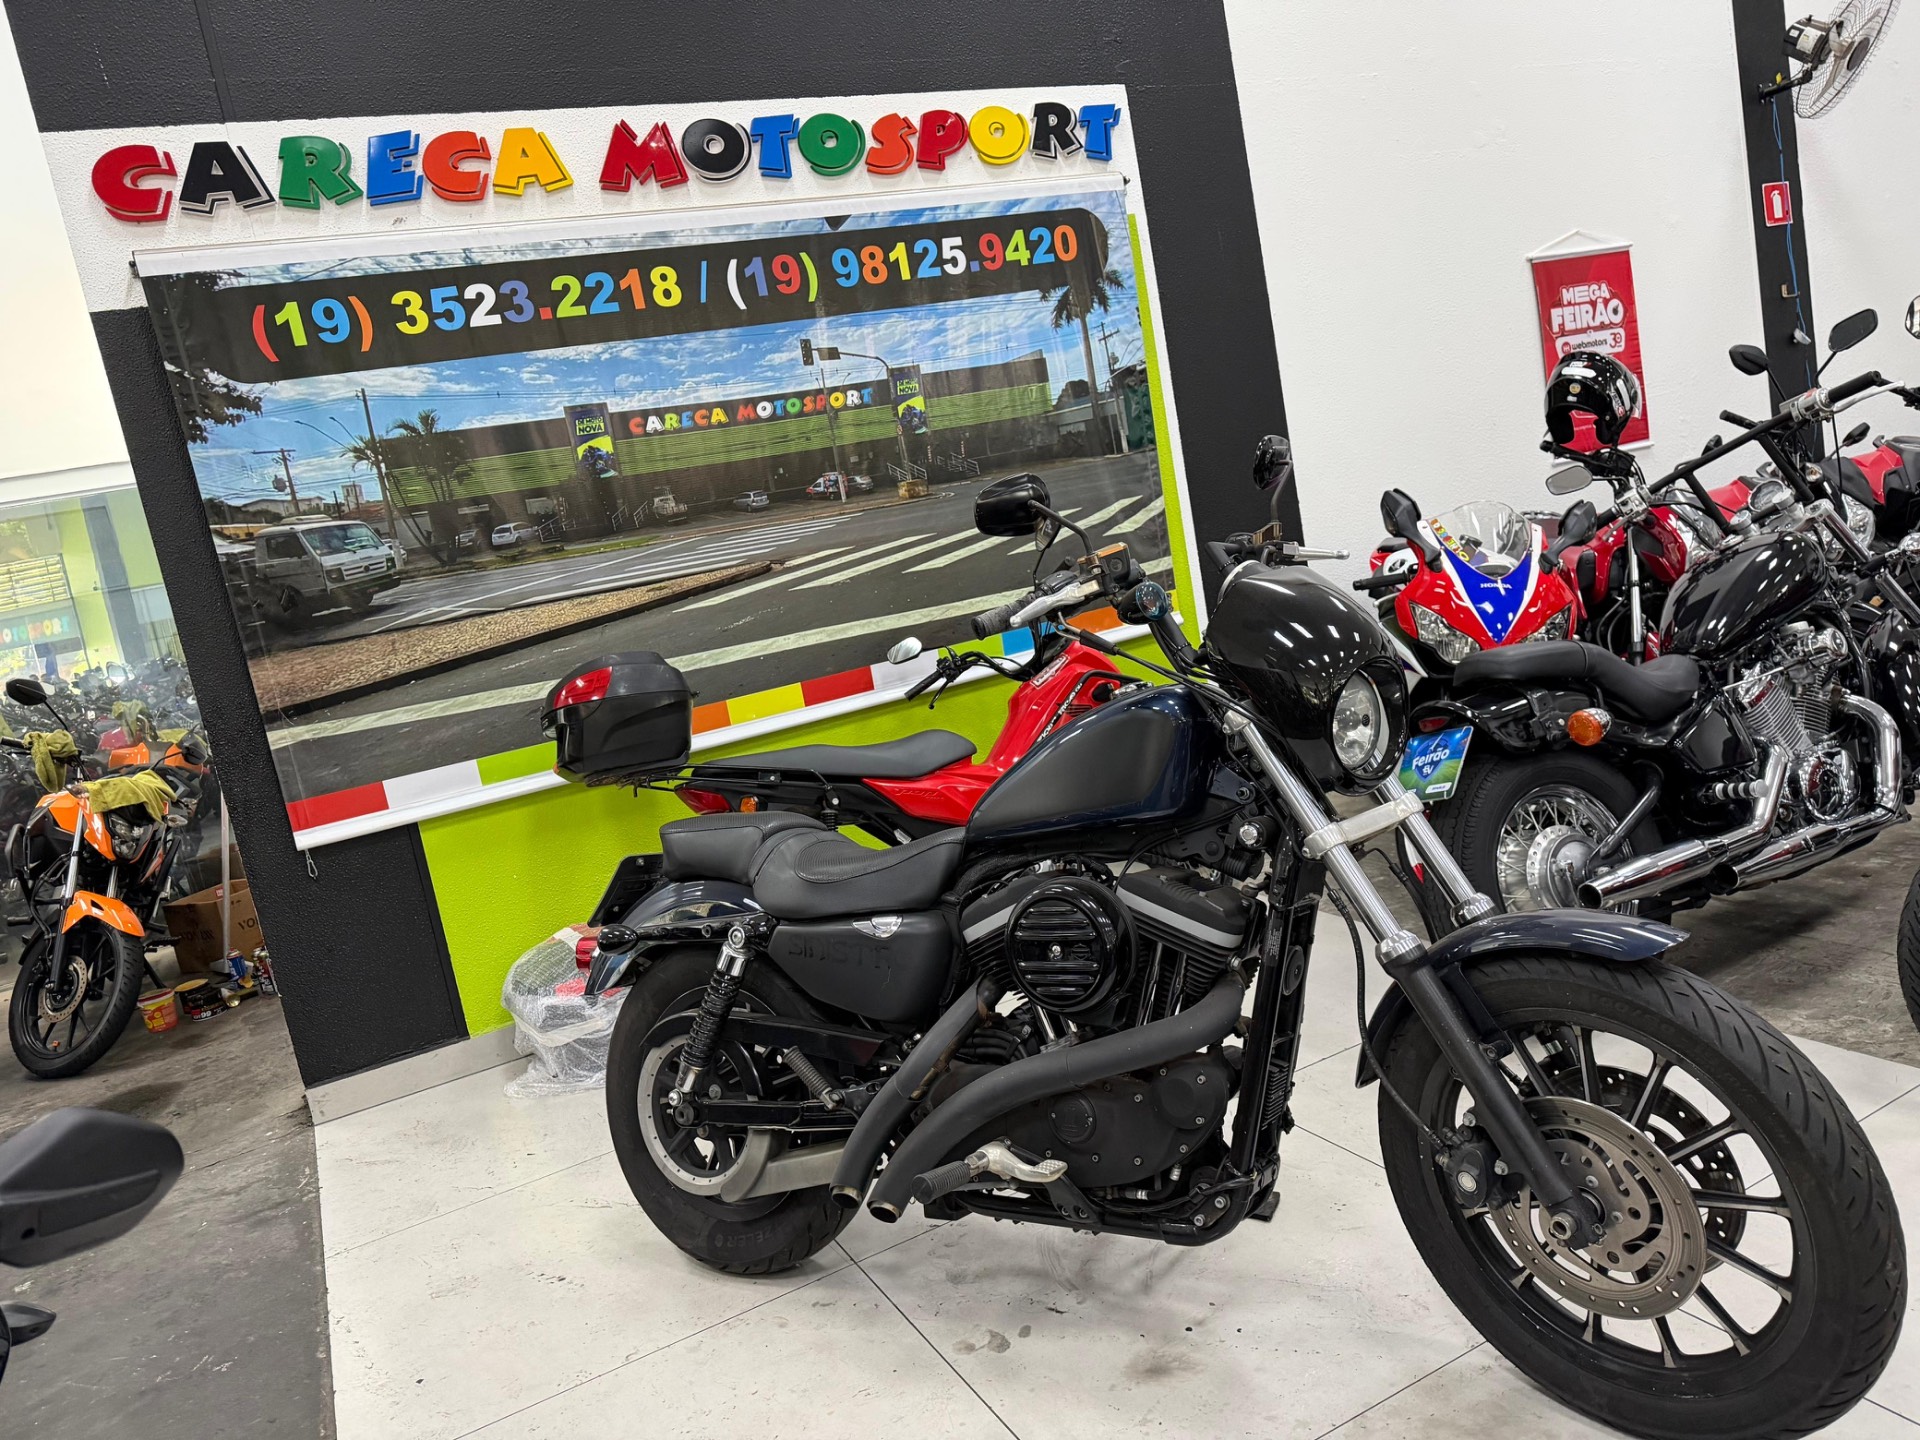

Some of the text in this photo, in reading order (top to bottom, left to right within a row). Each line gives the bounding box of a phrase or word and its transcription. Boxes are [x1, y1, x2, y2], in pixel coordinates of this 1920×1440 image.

[92, 102, 1121, 222] CARECA MOTOSPORT
[252, 296, 374, 362] (19)
[390, 265, 682, 335] 3523.2218
[727, 252, 818, 310] (19)
[831, 224, 1078, 288] 98125.9420
[1561, 282, 1611, 305] MEGA
[1550, 298, 1624, 333] FEIRÃO
[1571, 338, 1608, 351] webmotors
[628, 387, 873, 436] CARECA MOTOSPORT
[577, 424, 603, 434] NOVA
[1411, 747, 1450, 770] Feirão
